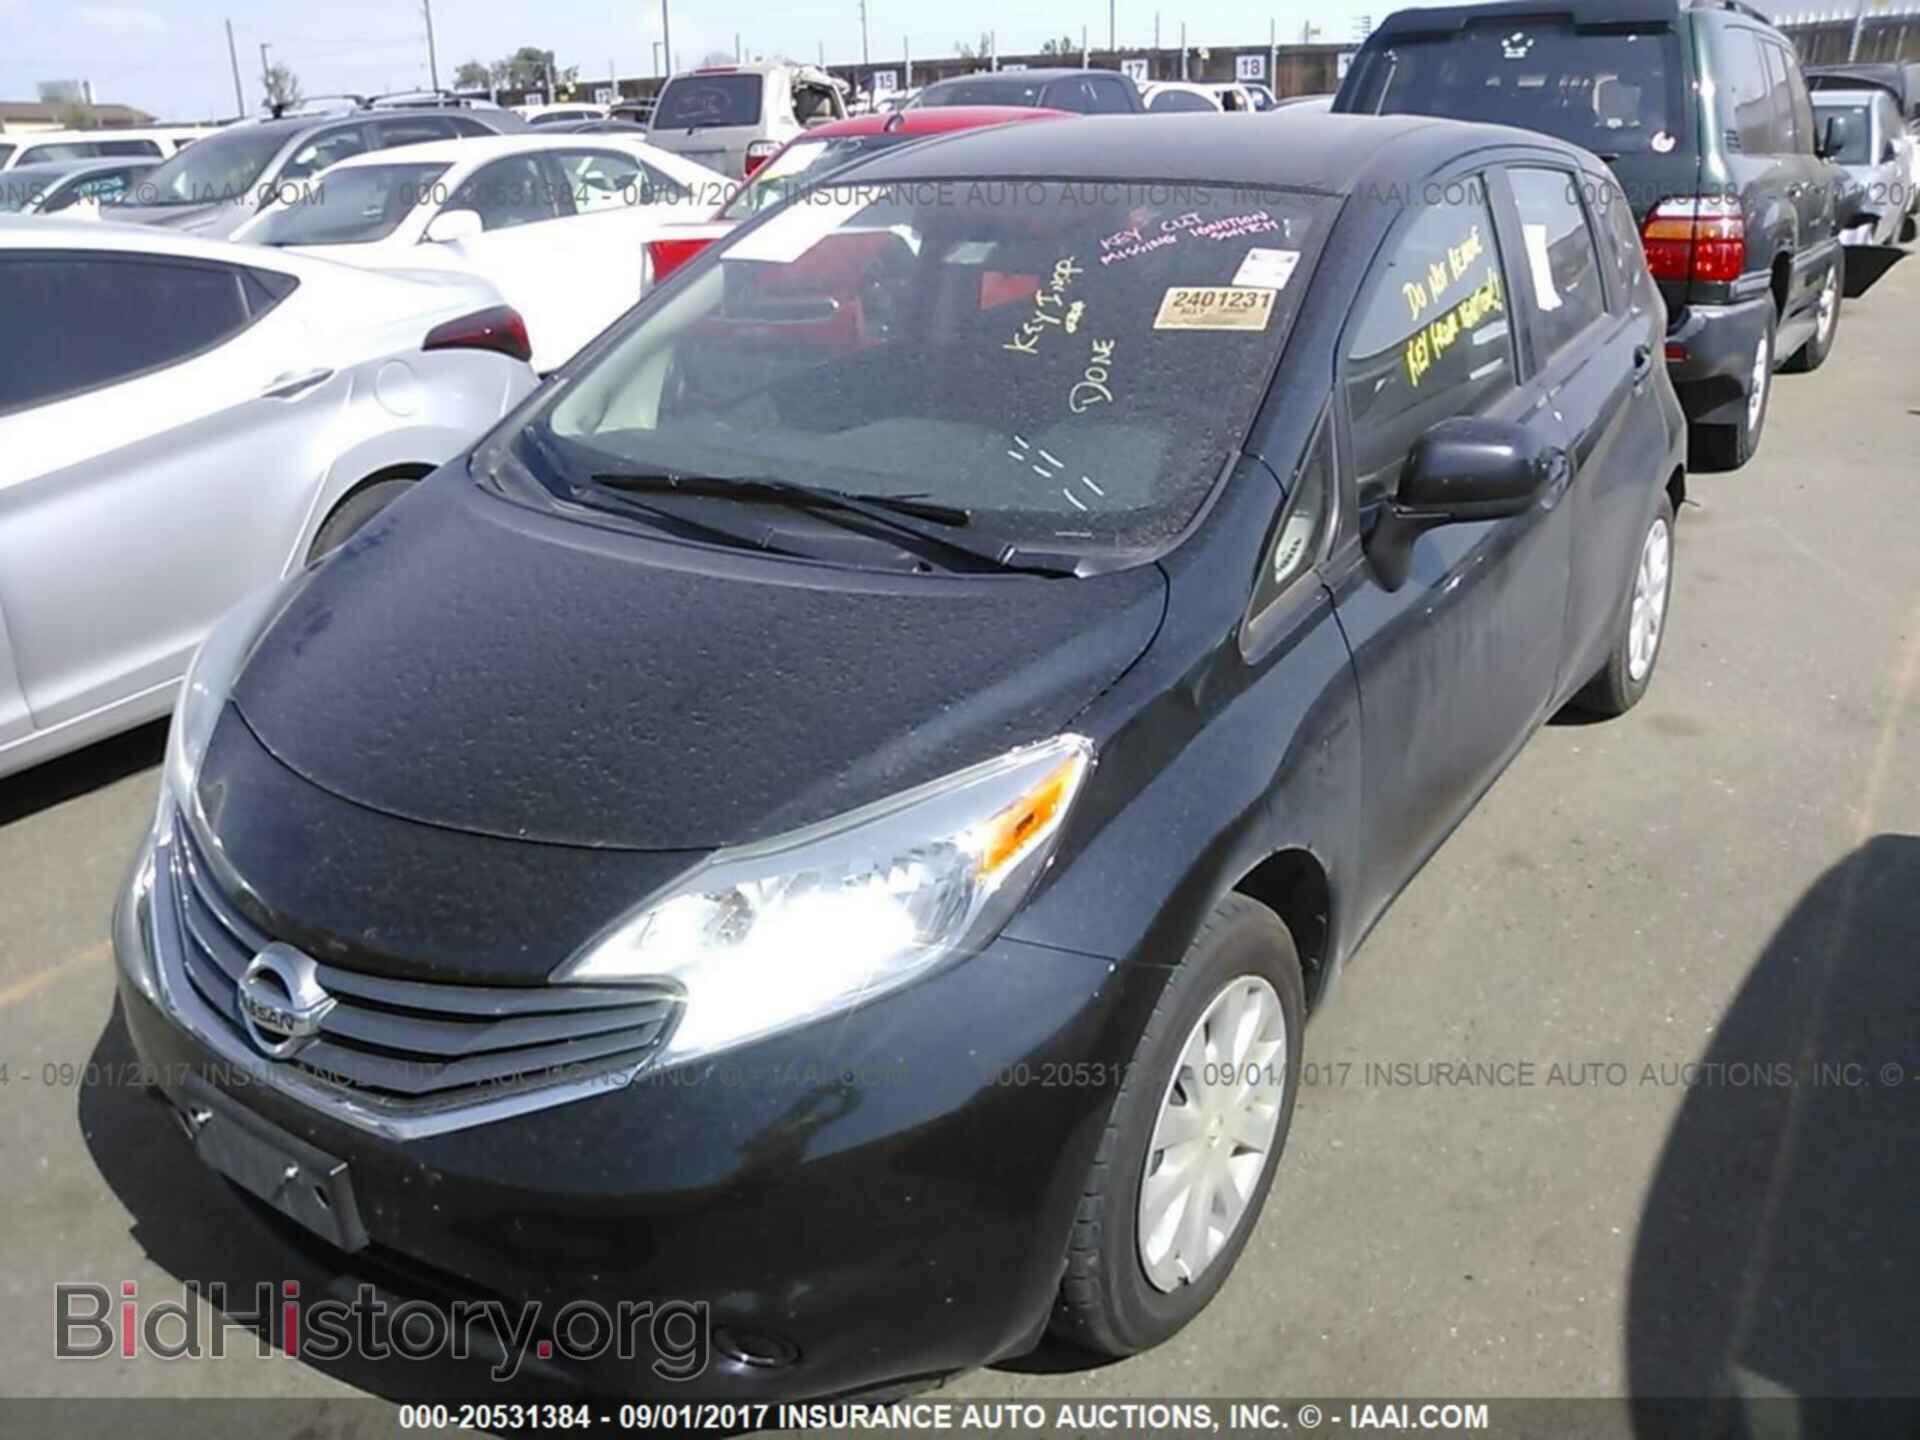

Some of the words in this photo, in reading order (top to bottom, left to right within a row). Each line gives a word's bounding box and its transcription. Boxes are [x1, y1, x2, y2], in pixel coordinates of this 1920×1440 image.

[1126, 63, 1145, 79] 17
[1242, 58, 1261, 76] 18
[879, 74, 894, 89] 15
[1101, 227, 1143, 251] KEY
[1160, 212, 1204, 233] CUT
[1172, 290, 1272, 309] 2401231
[1069, 338, 1115, 413] DONE
